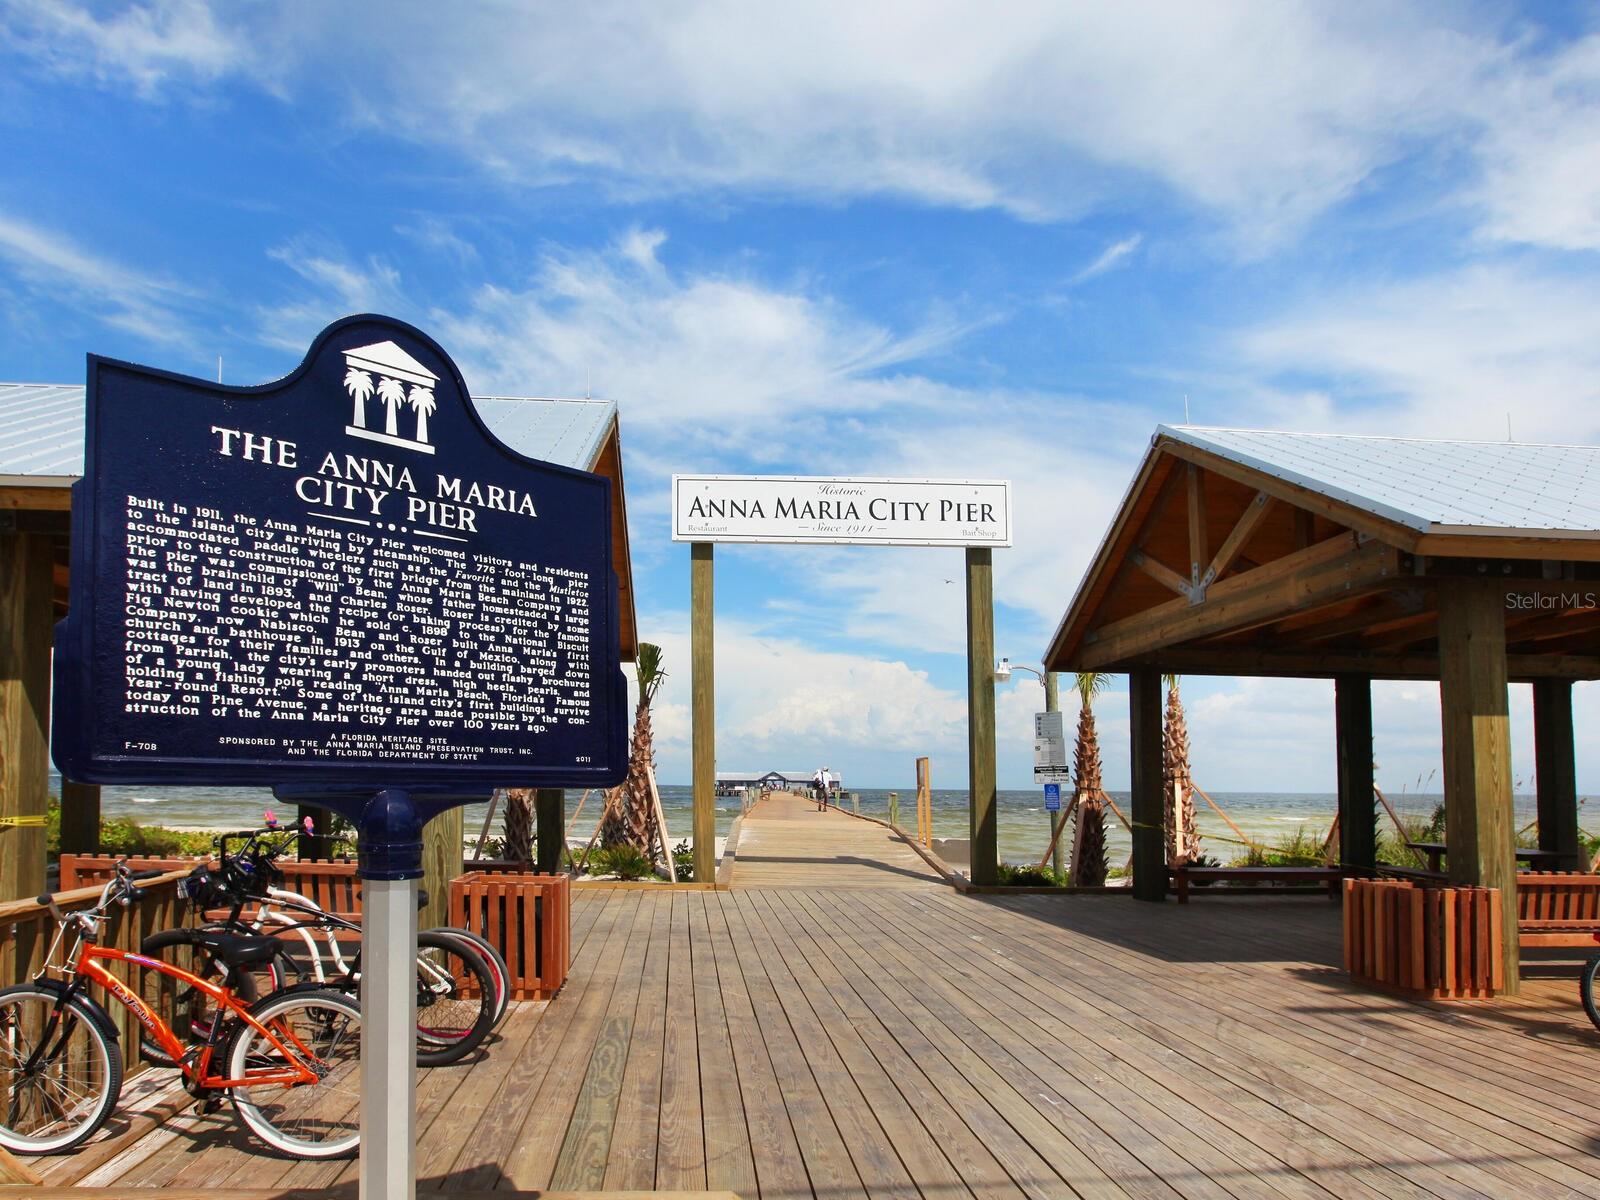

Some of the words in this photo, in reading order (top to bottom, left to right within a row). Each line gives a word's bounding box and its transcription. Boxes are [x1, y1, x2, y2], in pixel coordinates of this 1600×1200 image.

[211, 426, 297, 468] THE
[318, 452, 417, 493] ANNA
[437, 474, 538, 518] MARIA
[817, 484, 866, 496] Historic
[295, 476, 389, 516] CITY
[407, 496, 478, 532] PIER
[688, 496, 766, 518] ANNA
[774, 497, 861, 520] MARIA
[868, 498, 930, 521] CITY
[940, 500, 997, 522] PIER
[127, 496, 164, 511] Built
[173, 503, 187, 514] in
[233, 514, 256, 525] the
[264, 519, 297, 532] Anna
[306, 525, 342, 539] Maria
[347, 532, 374, 546] City
[381, 538, 405, 549] Pier
[412, 544, 465, 560] welcomed
[472, 554, 512, 567] visitors
[519, 562, 537, 571] and
[544, 566, 588, 580] residents
[688, 524, 728, 532] Restaurant
[812, 522, 842, 532] Since
[846, 525, 874, 534] 1911
[978, 530, 997, 538] Shop
[126, 521, 239, 546] accommodated
[254, 541, 299, 554] paddle
[308, 549, 365, 564] wheelers
[372, 559, 399, 569] such
[407, 564, 420, 572] as
[429, 566, 447, 576] the
[455, 570, 494, 583] Favorite
[500, 578, 518, 587] and
[524, 581, 541, 590] the
[548, 584, 589, 598] Mistletoe
[126, 544, 156, 557] The
[166, 551, 198, 562] pier
[207, 557, 235, 568] was
[248, 562, 339, 582] commissioned
[347, 574, 363, 588] by
[373, 578, 393, 589] the
[400, 582, 430, 594] Anna
[439, 587, 471, 600] Maria
[478, 592, 508, 605] Beach
[516, 598, 562, 613] Company
[571, 607, 589, 616] and
[126, 569, 167, 583] tract
[176, 576, 193, 585] of
[203, 578, 233, 590] land
[240, 583, 253, 593] in
[308, 593, 332, 602] and
[340, 595, 387, 609] Charles
[396, 602, 430, 615] Roser.
[442, 607, 474, 620] Roser
[480, 612, 489, 622] is
[494, 616, 537, 628] credited
[547, 621, 559, 631] by
[566, 625, 589, 634] some
[126, 582, 162, 594] with
[170, 586, 221, 603] having
[230, 593, 301, 610] developed
[309, 602, 330, 613] the
[338, 607, 378, 619] recipe
[387, 611, 405, 621] (or
[412, 614, 450, 629] baking
[458, 621, 505, 633] process)
[512, 626, 528, 635] for
[533, 629, 549, 638] the
[557, 631, 589, 643] famous
[126, 630, 195, 645] cottages
[207, 636, 230, 646] for
[239, 639, 275, 650] their
[285, 644, 338, 656] families
[349, 650, 372, 660] and
[381, 653, 421, 664] others.
[435, 657, 446, 666] In
[469, 660, 513, 674] building
[520, 664, 555, 676] barged
[565, 669, 590, 679] down
[216, 616, 244, 626] now
[260, 619, 317, 633] Nabisco.
[335, 626, 365, 638] Bean
[378, 632, 399, 641] and
[409, 634, 442, 646] Roser
[452, 638, 478, 650] built
[487, 643, 513, 653] Anna
[522, 646, 557, 658] Maria's
[567, 651, 589, 661] first
[125, 642, 164, 653] from
[247, 652, 270, 662] the
[278, 655, 316, 666] city's
[323, 659, 357, 670] early
[364, 663, 425, 675] promoters
[433, 667, 472, 679] handed
[477, 672, 495, 680] out
[501, 673, 533, 685] flashy
[542, 676, 590, 688] brochures
[125, 654, 142, 664] of
[156, 657, 165, 666] a
[176, 658, 220, 673] young
[234, 662, 265, 675] lady
[278, 666, 331, 681] wearing
[361, 672, 394, 683] short
[452, 679, 477, 690] high
[124, 703, 199, 715] struction
[211, 707, 227, 716] of
[237, 708, 260, 718] the
[271, 710, 304, 720] Anna
[312, 712, 349, 722] Maria
[360, 714, 387, 726] City
[396, 716, 420, 726] Pier
[428, 719, 454, 727] over
[463, 719, 483, 729] 100
[490, 722, 520, 730] years
[527, 724, 548, 733] ago.
[125, 742, 157, 751] F-708
[218, 736, 275, 745] SPONSORED
[391, 742, 421, 750] ISLAND
[426, 744, 483, 752] PRESERVATION
[341, 733, 377, 741] FLORIDA
[382, 735, 423, 743] HERITAGE
[379, 750, 434, 759] DEPARTMENT
